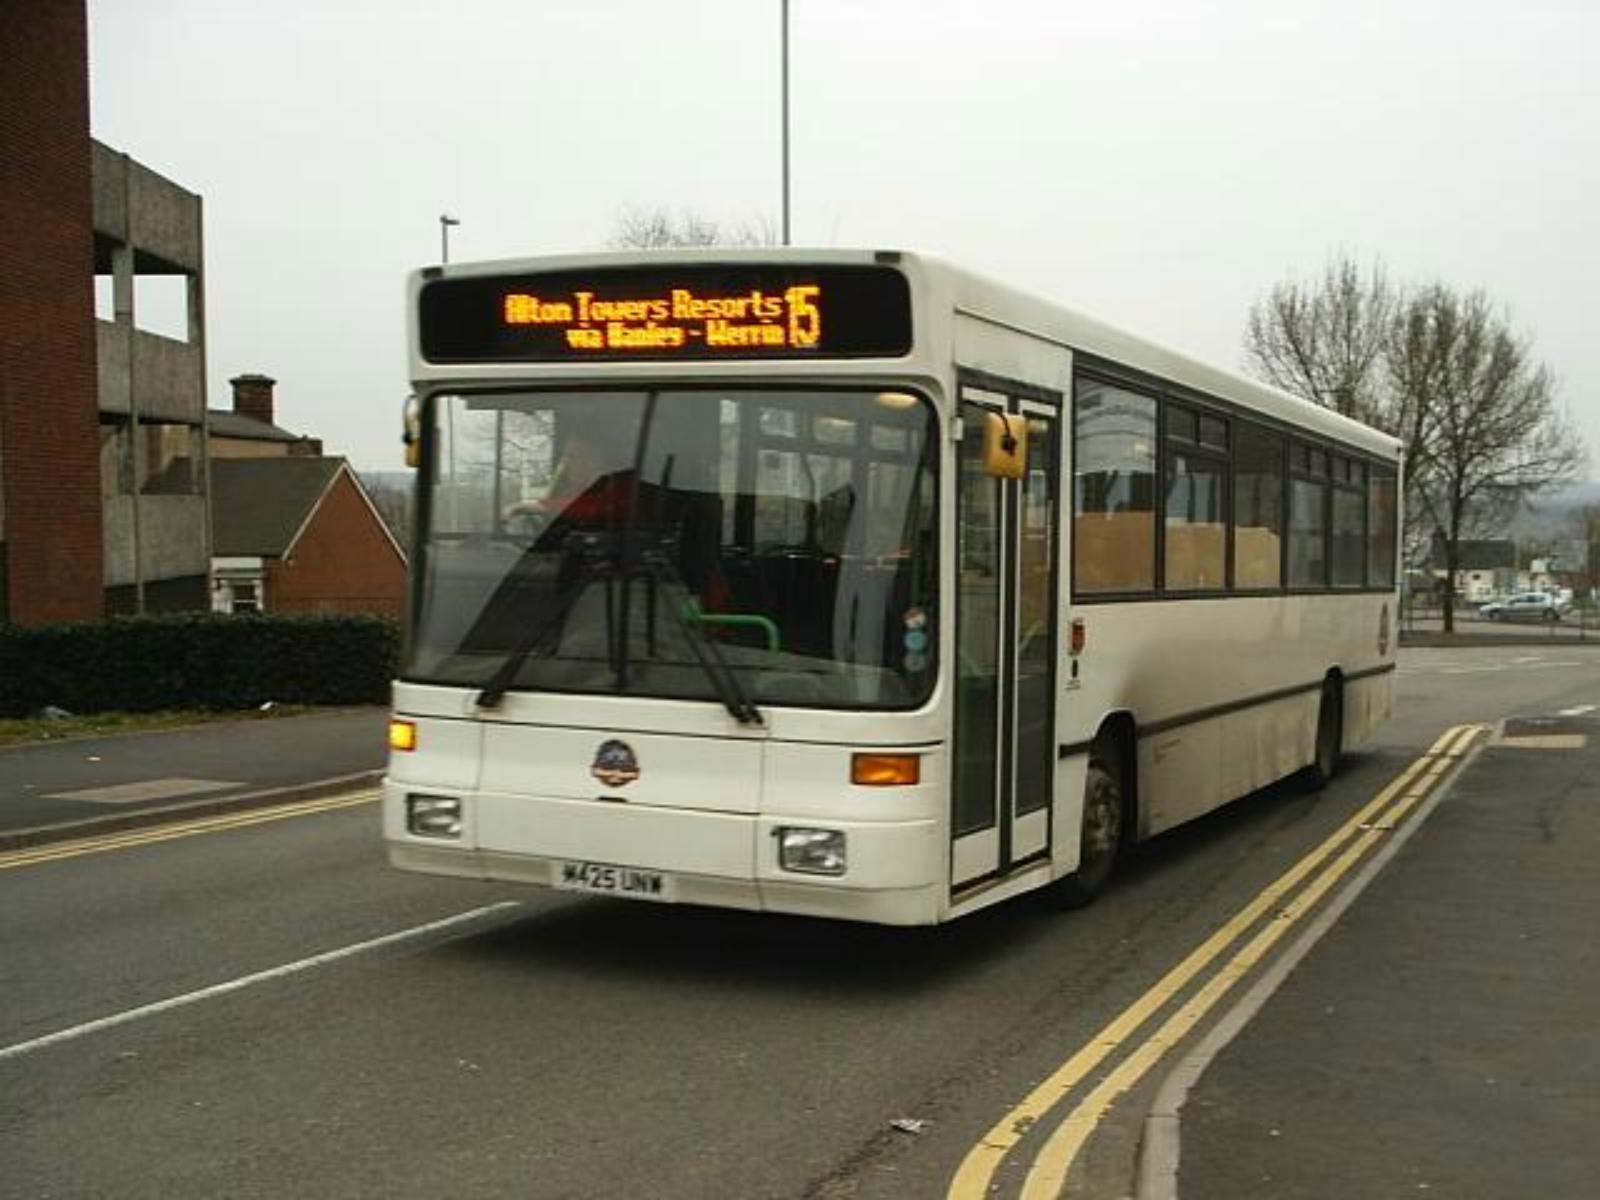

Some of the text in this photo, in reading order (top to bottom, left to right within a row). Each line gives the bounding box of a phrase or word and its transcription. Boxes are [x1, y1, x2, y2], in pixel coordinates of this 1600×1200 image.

[505, 288, 783, 324] Alton Towers Resorts
[785, 284, 821, 349] 15
[566, 322, 604, 349] via
